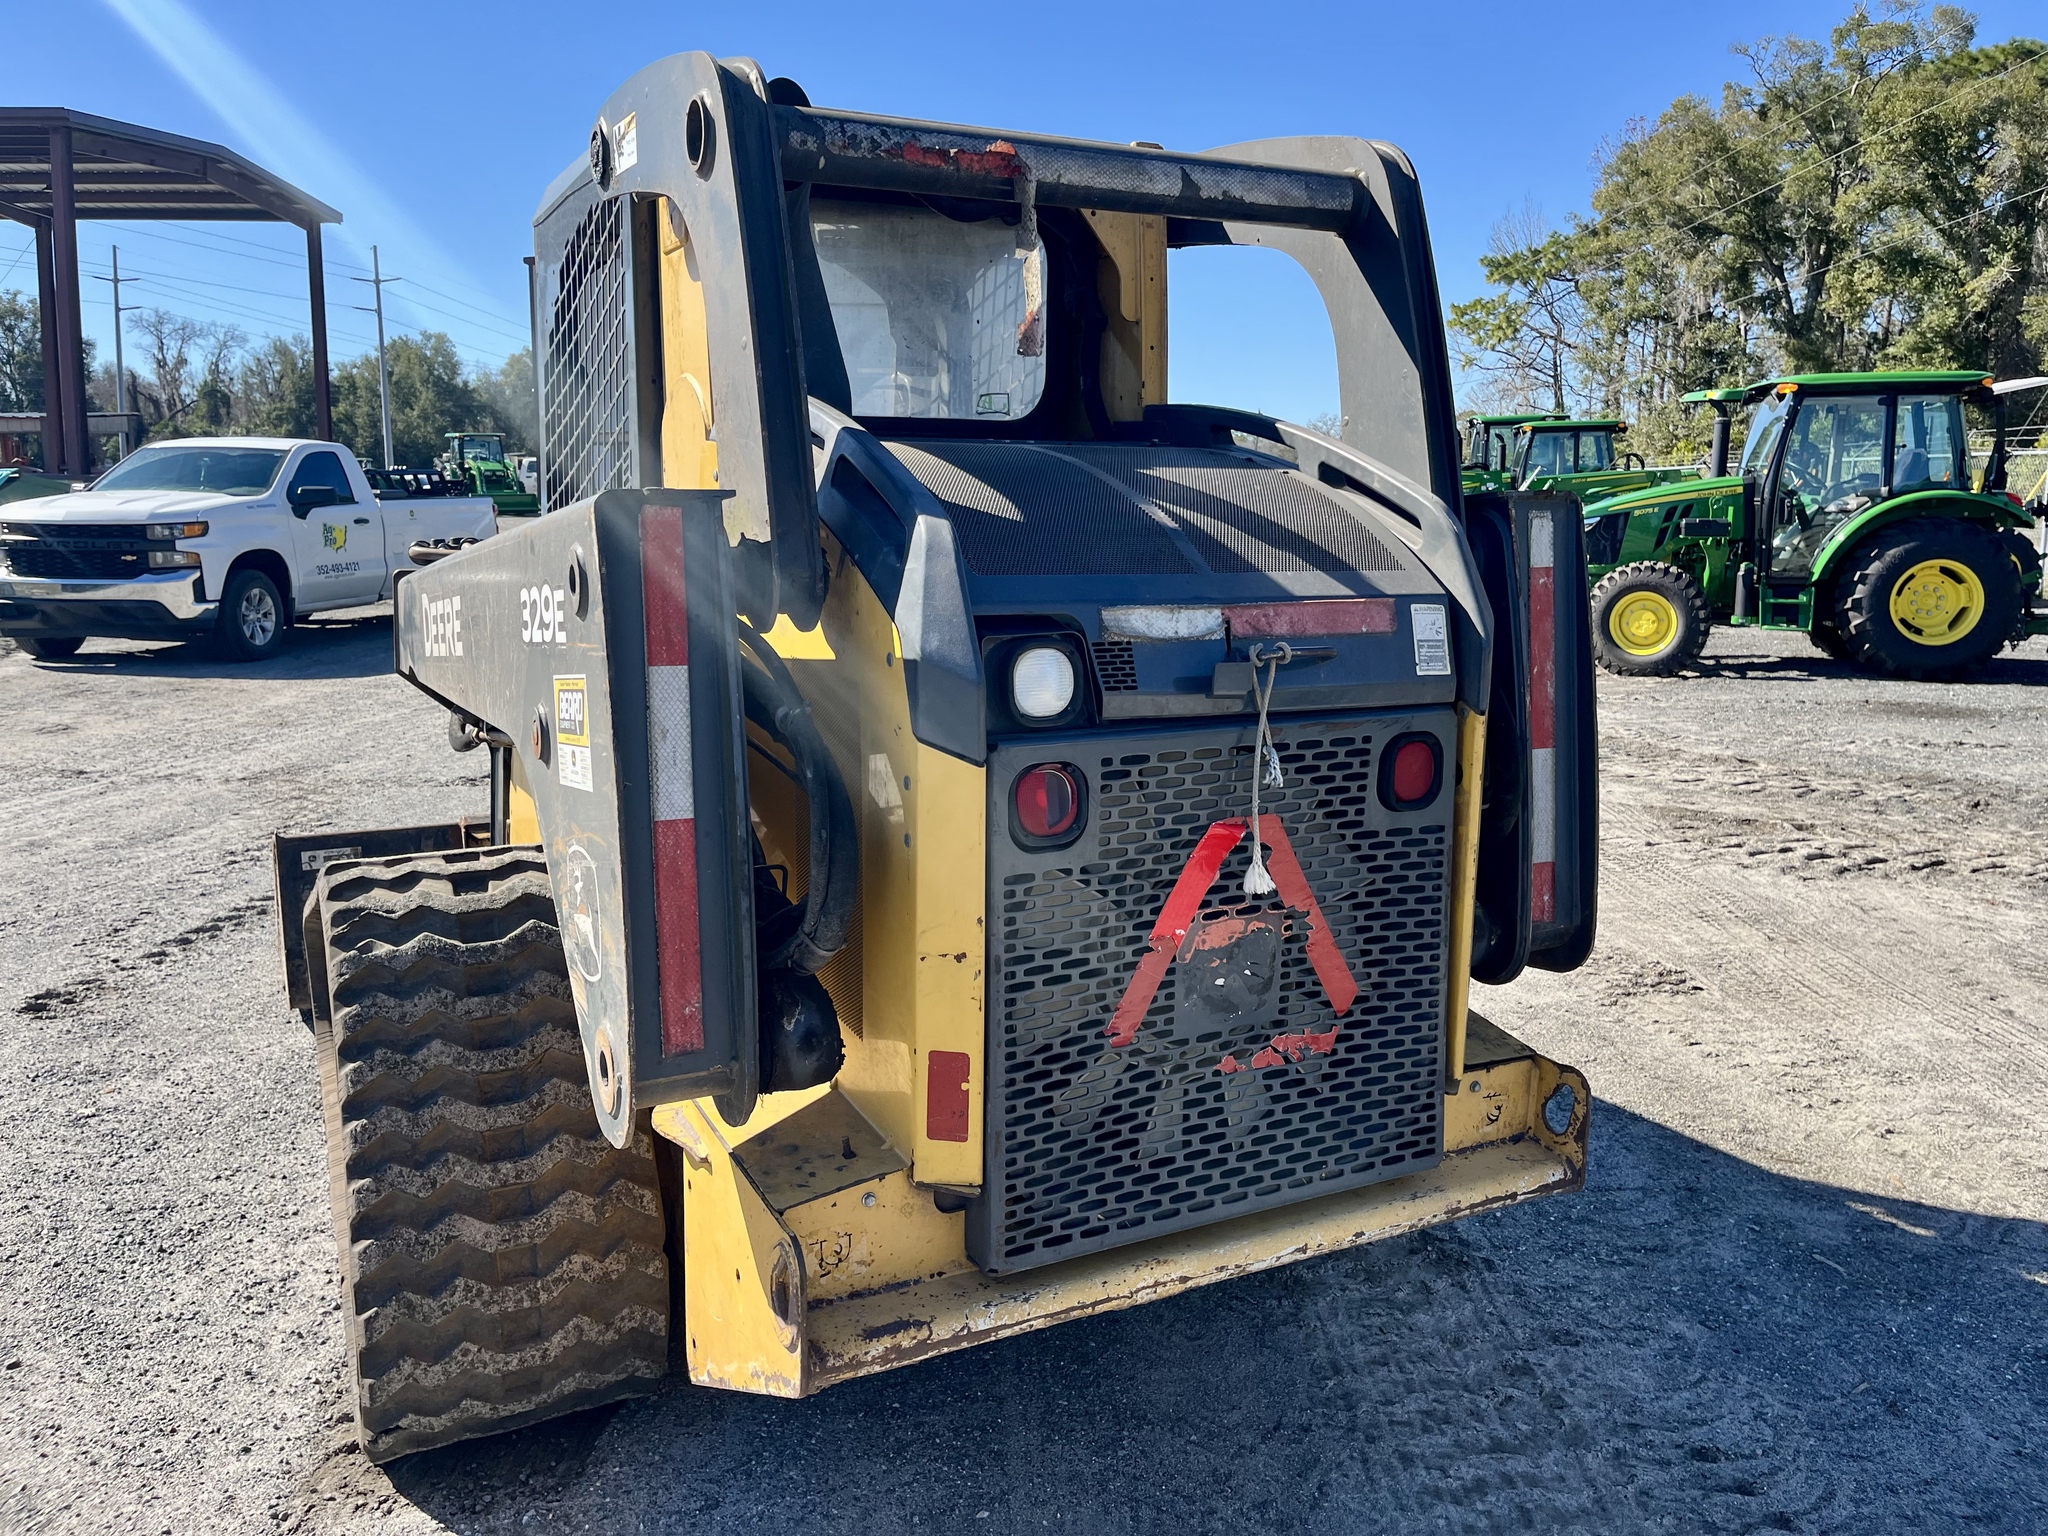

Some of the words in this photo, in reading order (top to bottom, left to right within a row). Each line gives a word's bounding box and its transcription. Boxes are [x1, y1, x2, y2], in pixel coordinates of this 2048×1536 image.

[1715, 488, 1738, 496] DEERE
[324, 535, 337, 547] Pro
[316, 561, 360, 576] 352-493-4121
[421, 592, 464, 657] DEERE
[520, 583, 567, 644] 329E
[559, 691, 583, 735] BEARD
